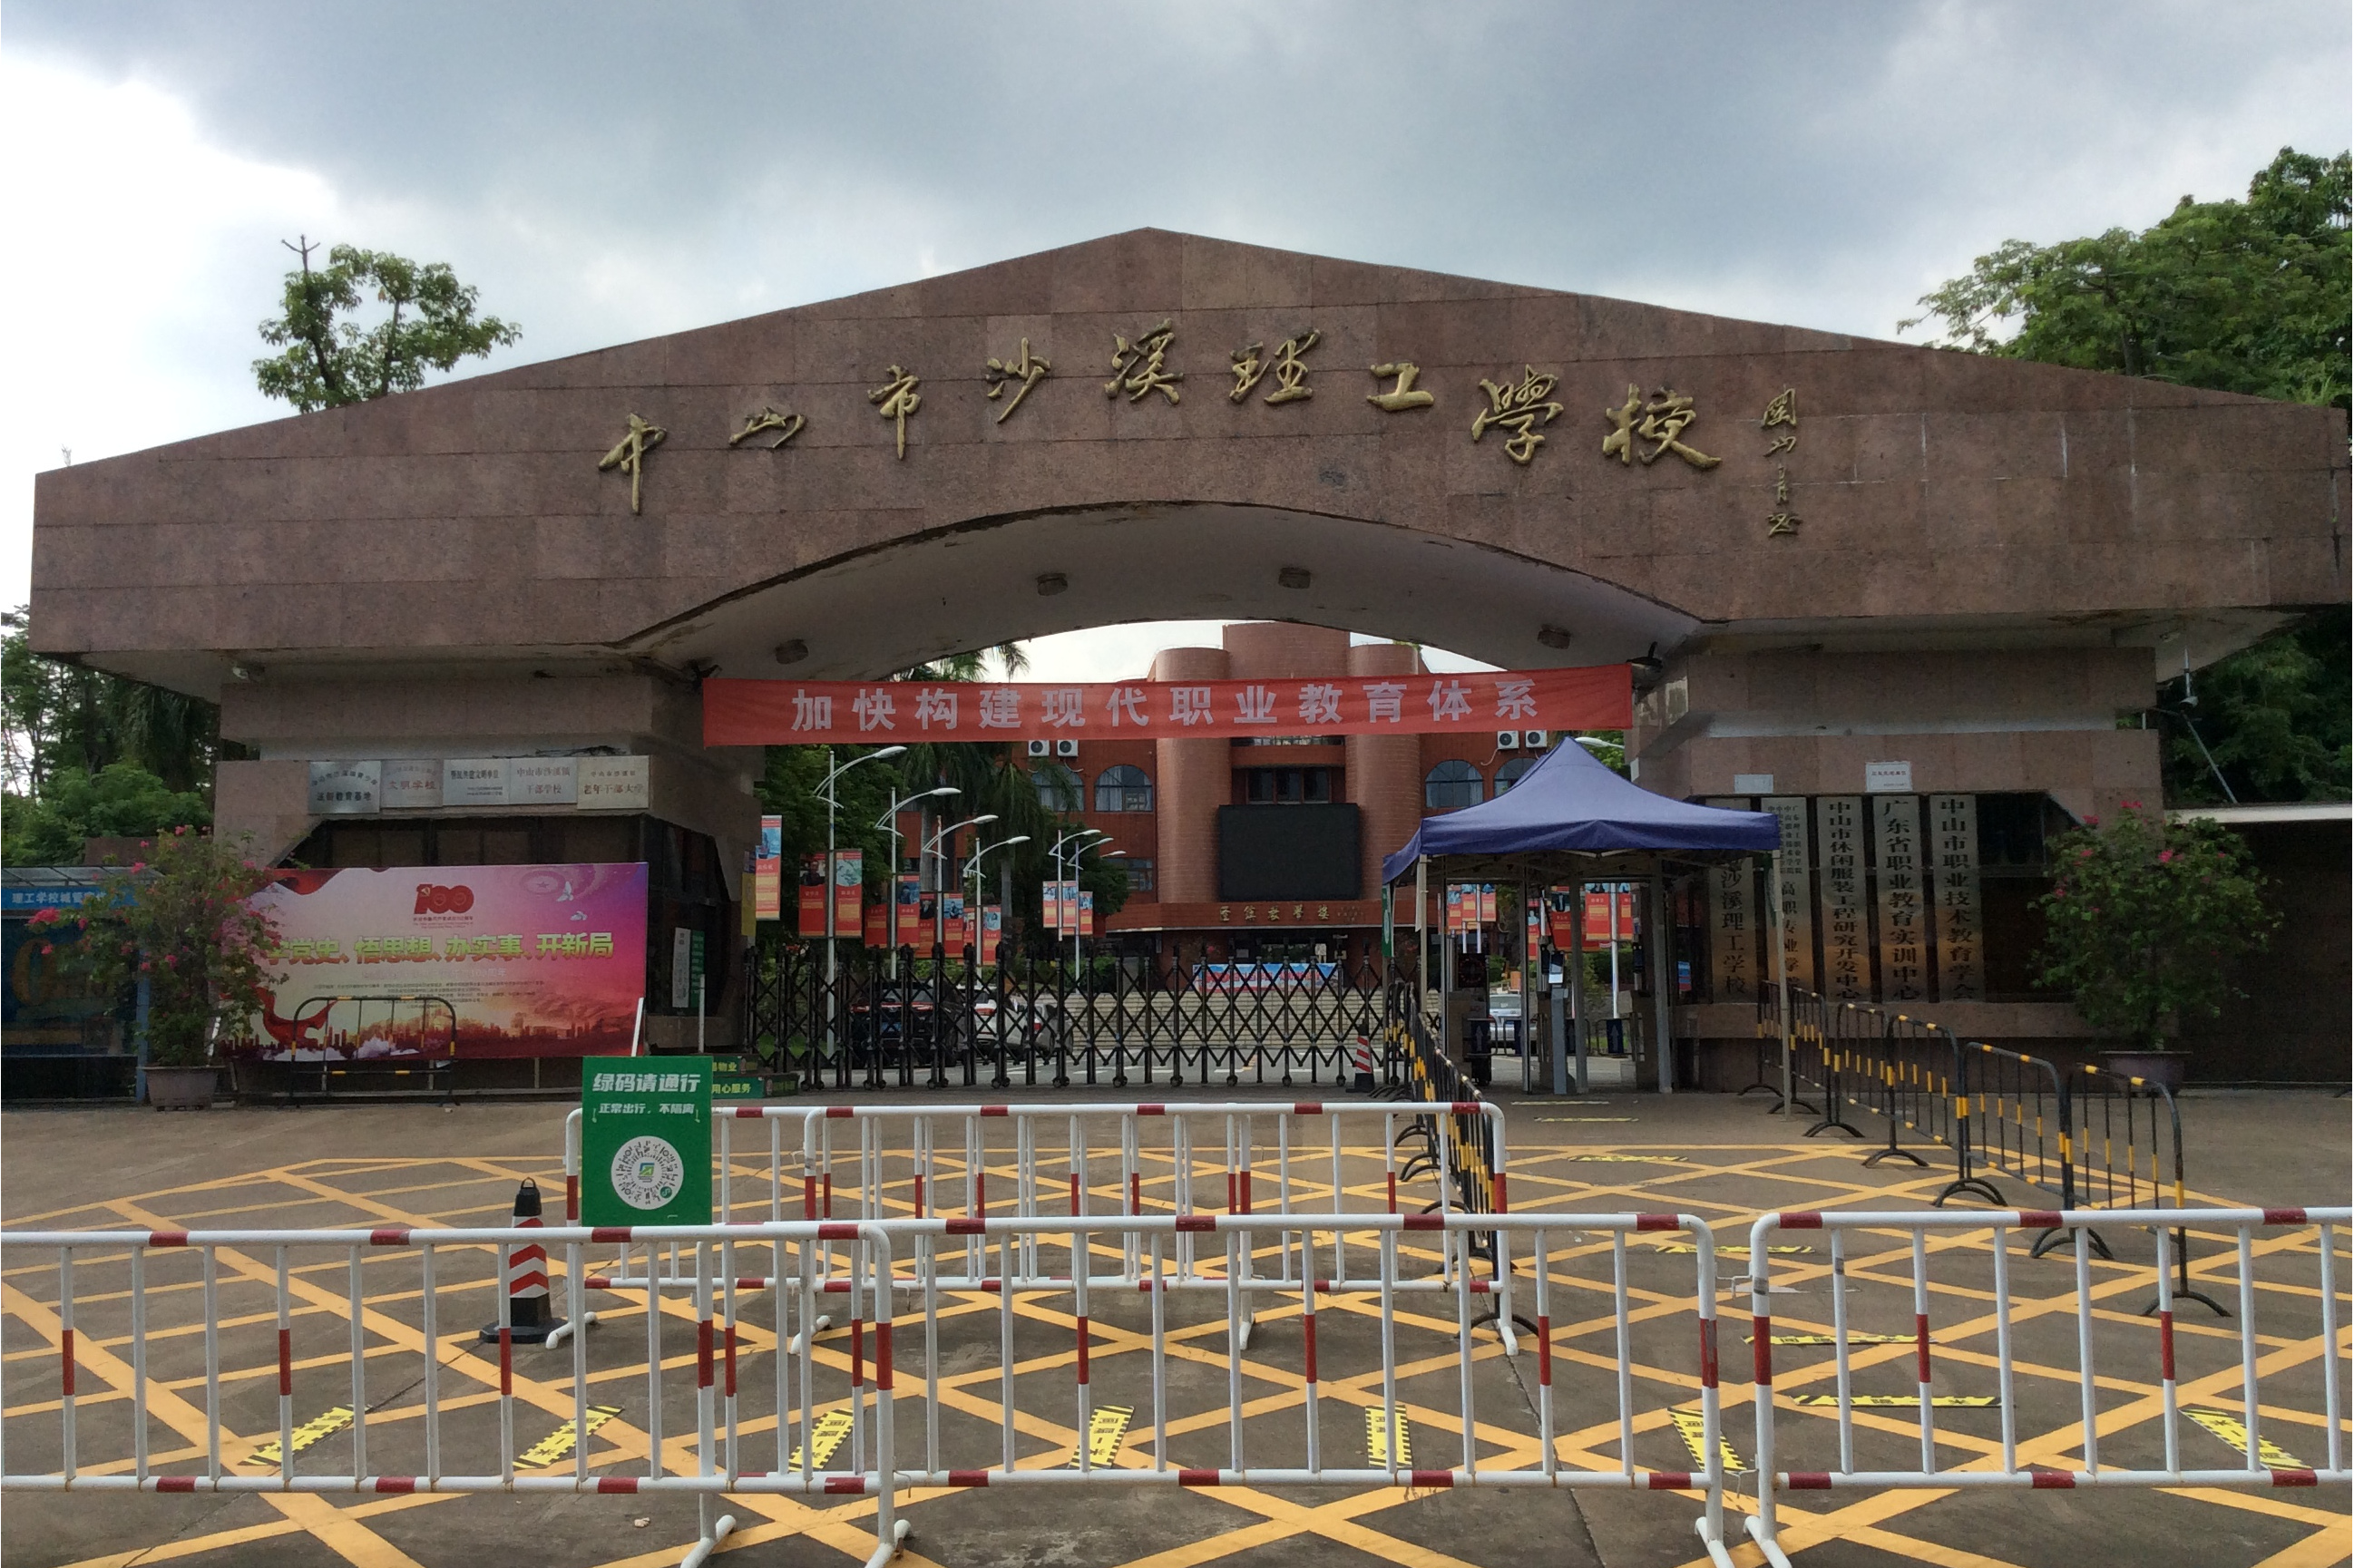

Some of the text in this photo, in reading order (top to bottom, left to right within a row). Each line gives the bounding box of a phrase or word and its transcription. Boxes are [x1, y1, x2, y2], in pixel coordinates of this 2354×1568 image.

[791, 679, 1538, 732] 加快构建现代职业教育体系
[584, 783, 644, 795] 老年干部大学
[1829, 801, 1861, 1000] 中山市休闲服装工程研究开发中心
[1884, 800, 1920, 1001] 广东省职业教育实训中心
[1940, 798, 1979, 1000] 中山市职业技术教育学会
[591, 1072, 702, 1093] 绿码请通行
[711, 1083, 752, 1095] 用心服务
